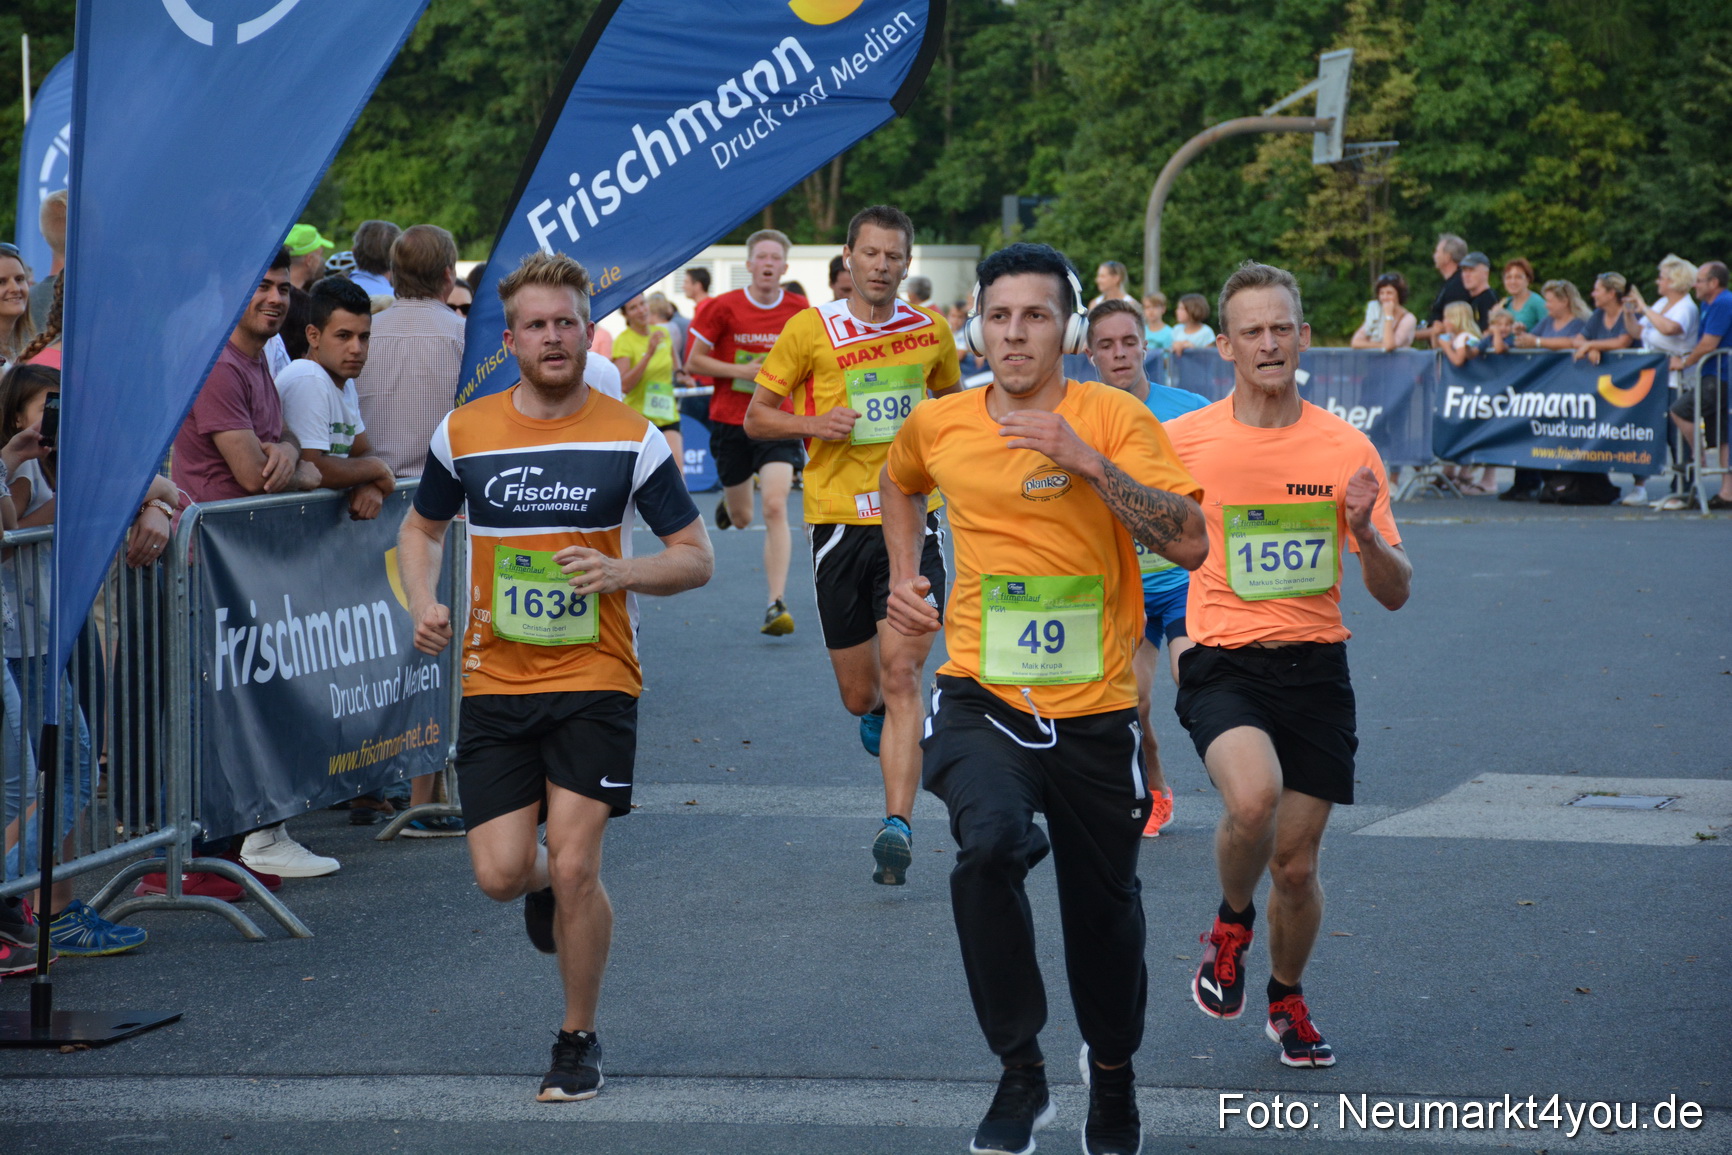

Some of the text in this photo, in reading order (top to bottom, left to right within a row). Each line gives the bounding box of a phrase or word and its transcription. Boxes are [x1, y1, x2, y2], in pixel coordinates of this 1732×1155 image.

[711, 11, 916, 170] Druck und Medien
[527, 36, 815, 256] Frischmann
[836, 332, 940, 370] MAX BÖGL
[866, 394, 911, 422] 898
[1443, 385, 1596, 419] Frischmann
[1530, 420, 1654, 441] Druck und Medien
[1531, 447, 1652, 465] www.frischmann-net.de
[503, 482, 596, 502] Fischer
[1286, 484, 1333, 496] THULE
[512, 502, 588, 512] AUTOMOBILE
[1240, 519, 1279, 528] firmenlauf
[1238, 539, 1325, 573] 1567
[509, 564, 545, 575] firmenlauf
[1249, 577, 1315, 587] Markus Schwandner
[504, 585, 587, 619] 1638
[1000, 593, 1041, 603] firmenlauf
[522, 624, 551, 632] Christian
[1017, 619, 1065, 654] 49
[214, 594, 397, 692] Frischmann
[1040, 663, 1063, 671] Krupa
[329, 674, 371, 719] Druck
[373, 666, 401, 708] und
